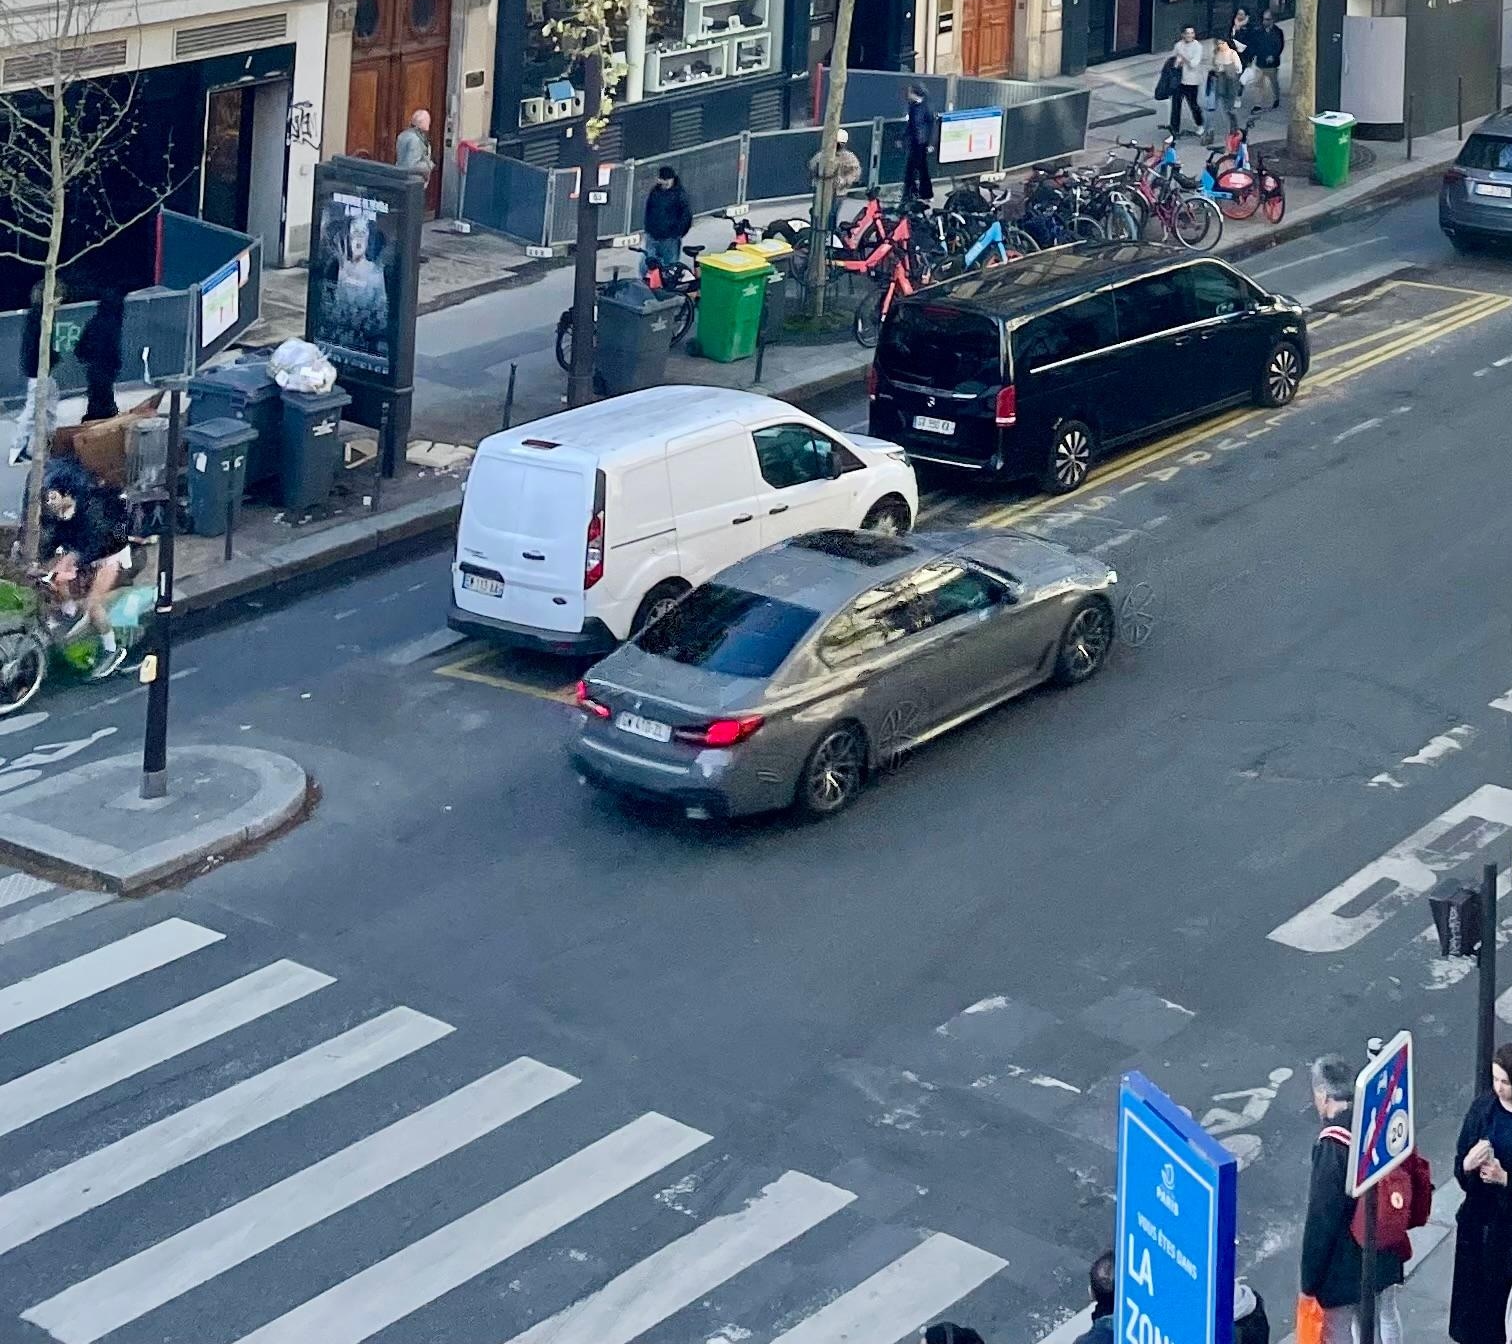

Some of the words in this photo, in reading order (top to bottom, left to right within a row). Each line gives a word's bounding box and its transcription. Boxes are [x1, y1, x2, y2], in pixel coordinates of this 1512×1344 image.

[1129, 1233, 1154, 1296] LA
[1137, 1211, 1157, 1241] VOUS
[1158, 1228, 1176, 1259] ÊTES
[1176, 1248, 1198, 1280] DANS
